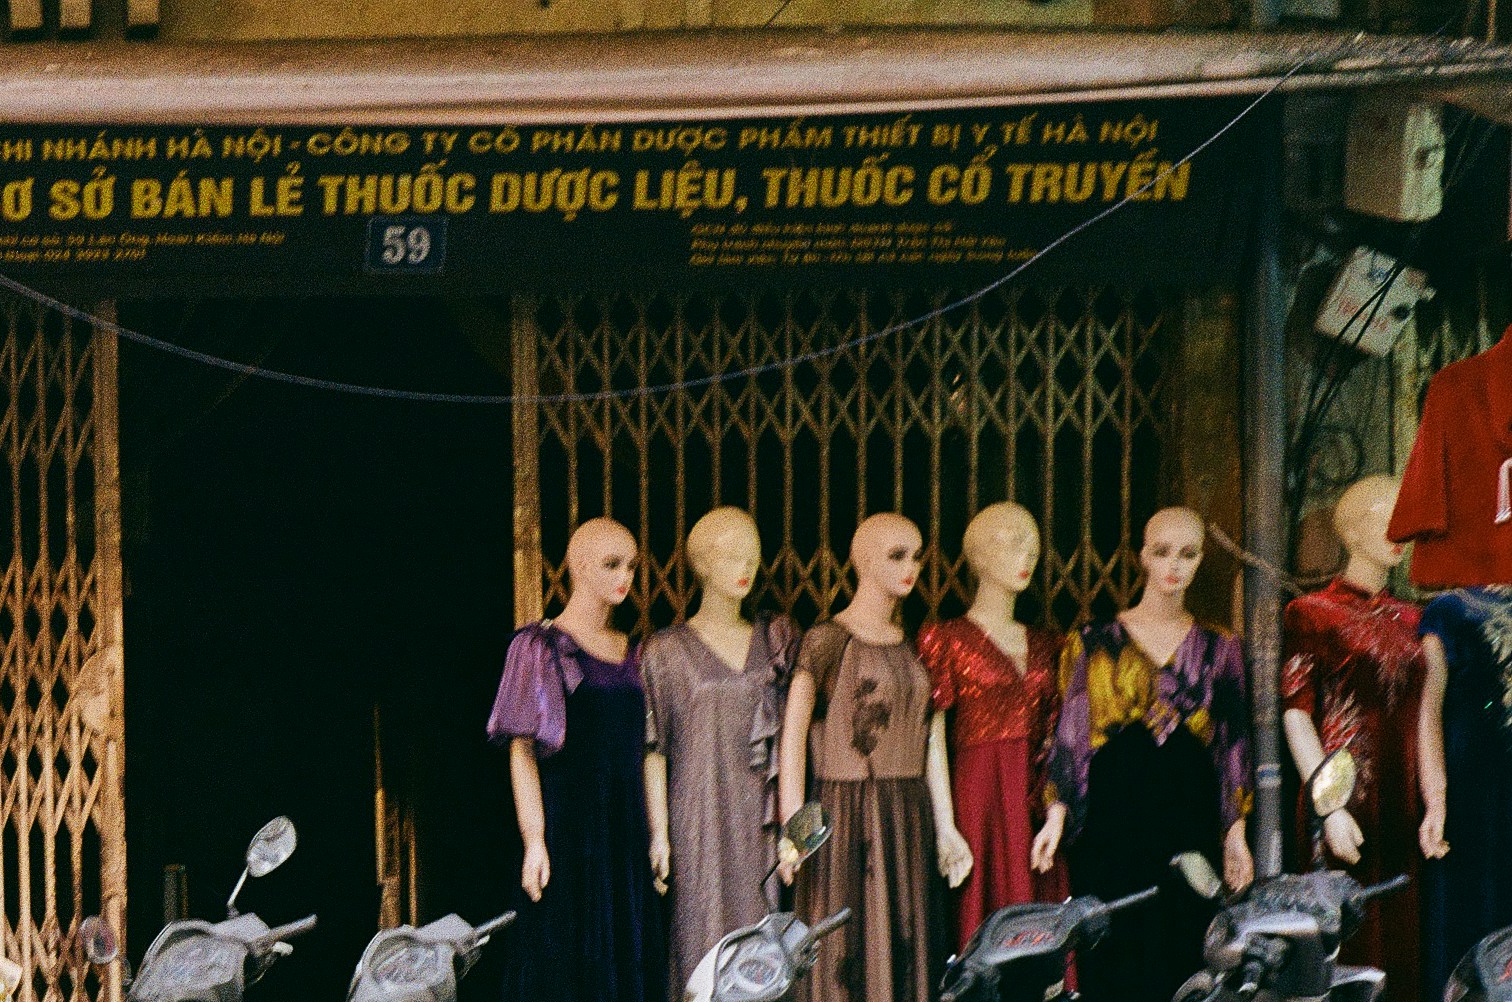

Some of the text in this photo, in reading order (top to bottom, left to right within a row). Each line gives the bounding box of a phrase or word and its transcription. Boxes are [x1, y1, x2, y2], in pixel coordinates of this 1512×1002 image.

[43, 130, 157, 161] NHÁNH
[222, 128, 281, 163] NỘI
[307, 126, 411, 156] CÔNG
[422, 131, 459, 154] TY
[632, 125, 727, 157] DƯỢC
[842, 113, 923, 149] THIẾT
[931, 123, 961, 151] BỊ
[970, 123, 992, 146] Y
[1001, 111, 1039, 145] TẾ
[1099, 113, 1160, 149] NỘI
[49, 165, 117, 221] SỞ
[131, 169, 234, 219] BÁN
[250, 161, 305, 217] LẺ
[317, 158, 476, 217] THUỐC
[489, 167, 620, 222] DƯỢC
[632, 159, 749, 219] LIỆU,
[762, 152, 916, 209] THUỐC
[926, 144, 999, 206] CỔ
[381, 223, 432, 265] 59
